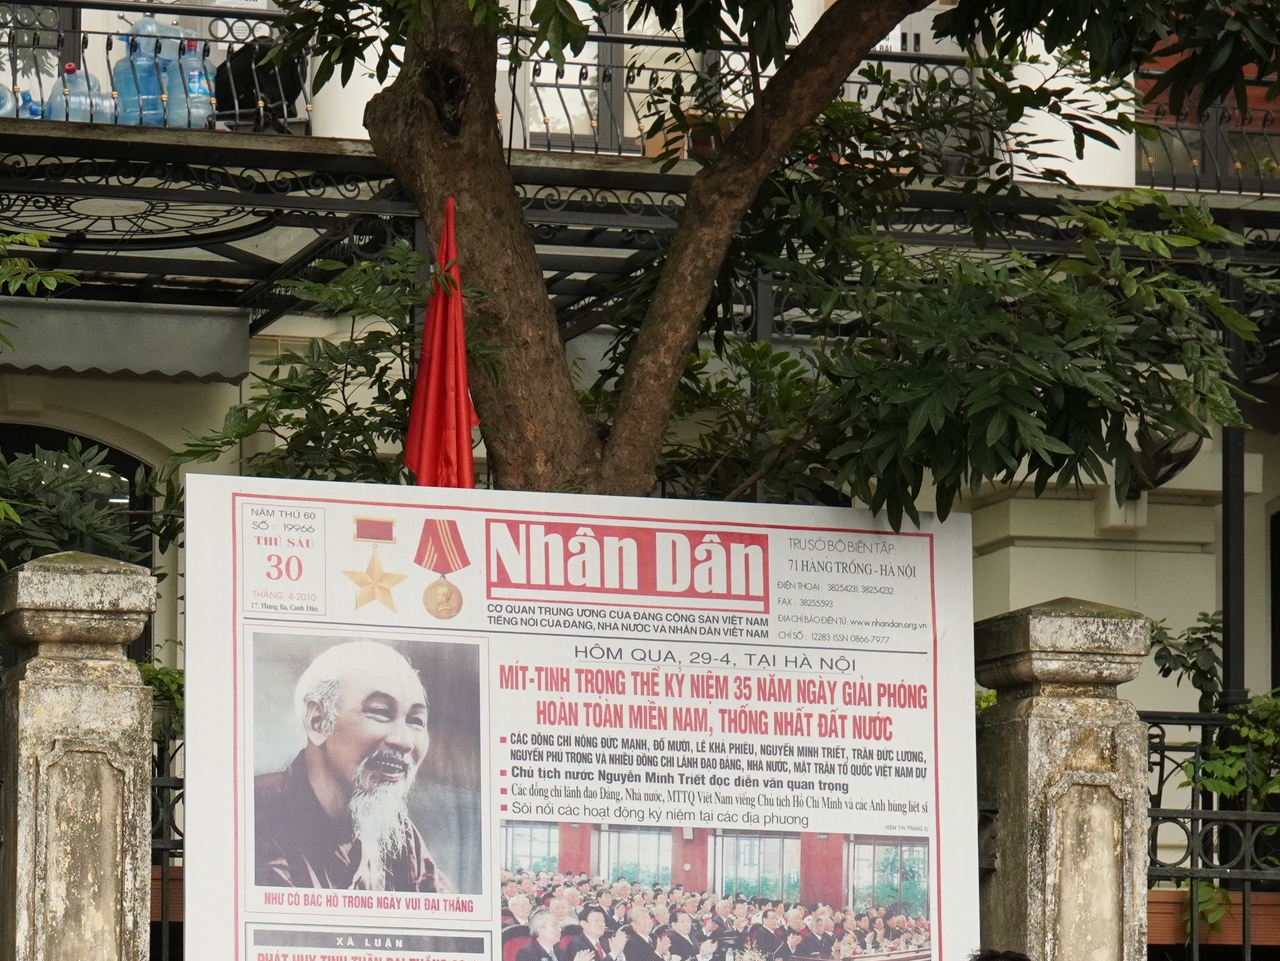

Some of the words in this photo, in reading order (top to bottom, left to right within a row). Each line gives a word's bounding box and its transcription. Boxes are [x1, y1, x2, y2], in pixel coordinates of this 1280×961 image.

[251, 508, 274, 517] NĂM
[303, 511, 315, 520] 60
[283, 523, 315, 533] 19966
[265, 554, 303, 581] 30
[490, 522, 638, 590] Nhân
[656, 531, 763, 596] Dân
[288, 592, 316, 601] 4-2010
[575, 644, 622, 660] HÔM
[631, 648, 681, 665] QUA,
[690, 651, 736, 667] 29-4,
[744, 653, 775, 669] TẠI
[784, 653, 812, 669] HÀ
[820, 655, 855, 672] NỘI
[500, 660, 570, 692] MÍT-TINH
[574, 668, 625, 699] TRỌNG
[630, 666, 660, 702] THỂ
[664, 667, 685, 697] KỶ
[690, 670, 728, 704] NIỆM
[733, 675, 752, 700] 35
[756, 673, 792, 702] NĂM
[796, 675, 838, 706] NGÀY
[842, 676, 872, 706] GIẢI
[877, 679, 927, 712] PHÓNG
[536, 698, 578, 726] HOÀN
[583, 700, 623, 728] TOÀN
[628, 702, 667, 730] MIỀN
[672, 706, 712, 736] NAM,
[718, 706, 768, 735] THỐNG
[774, 708, 813, 737] NHẤT
[817, 710, 847, 738] ĐẤT
[852, 712, 892, 741] NƯỚC
[365, 936, 403, 949] LUẬN
